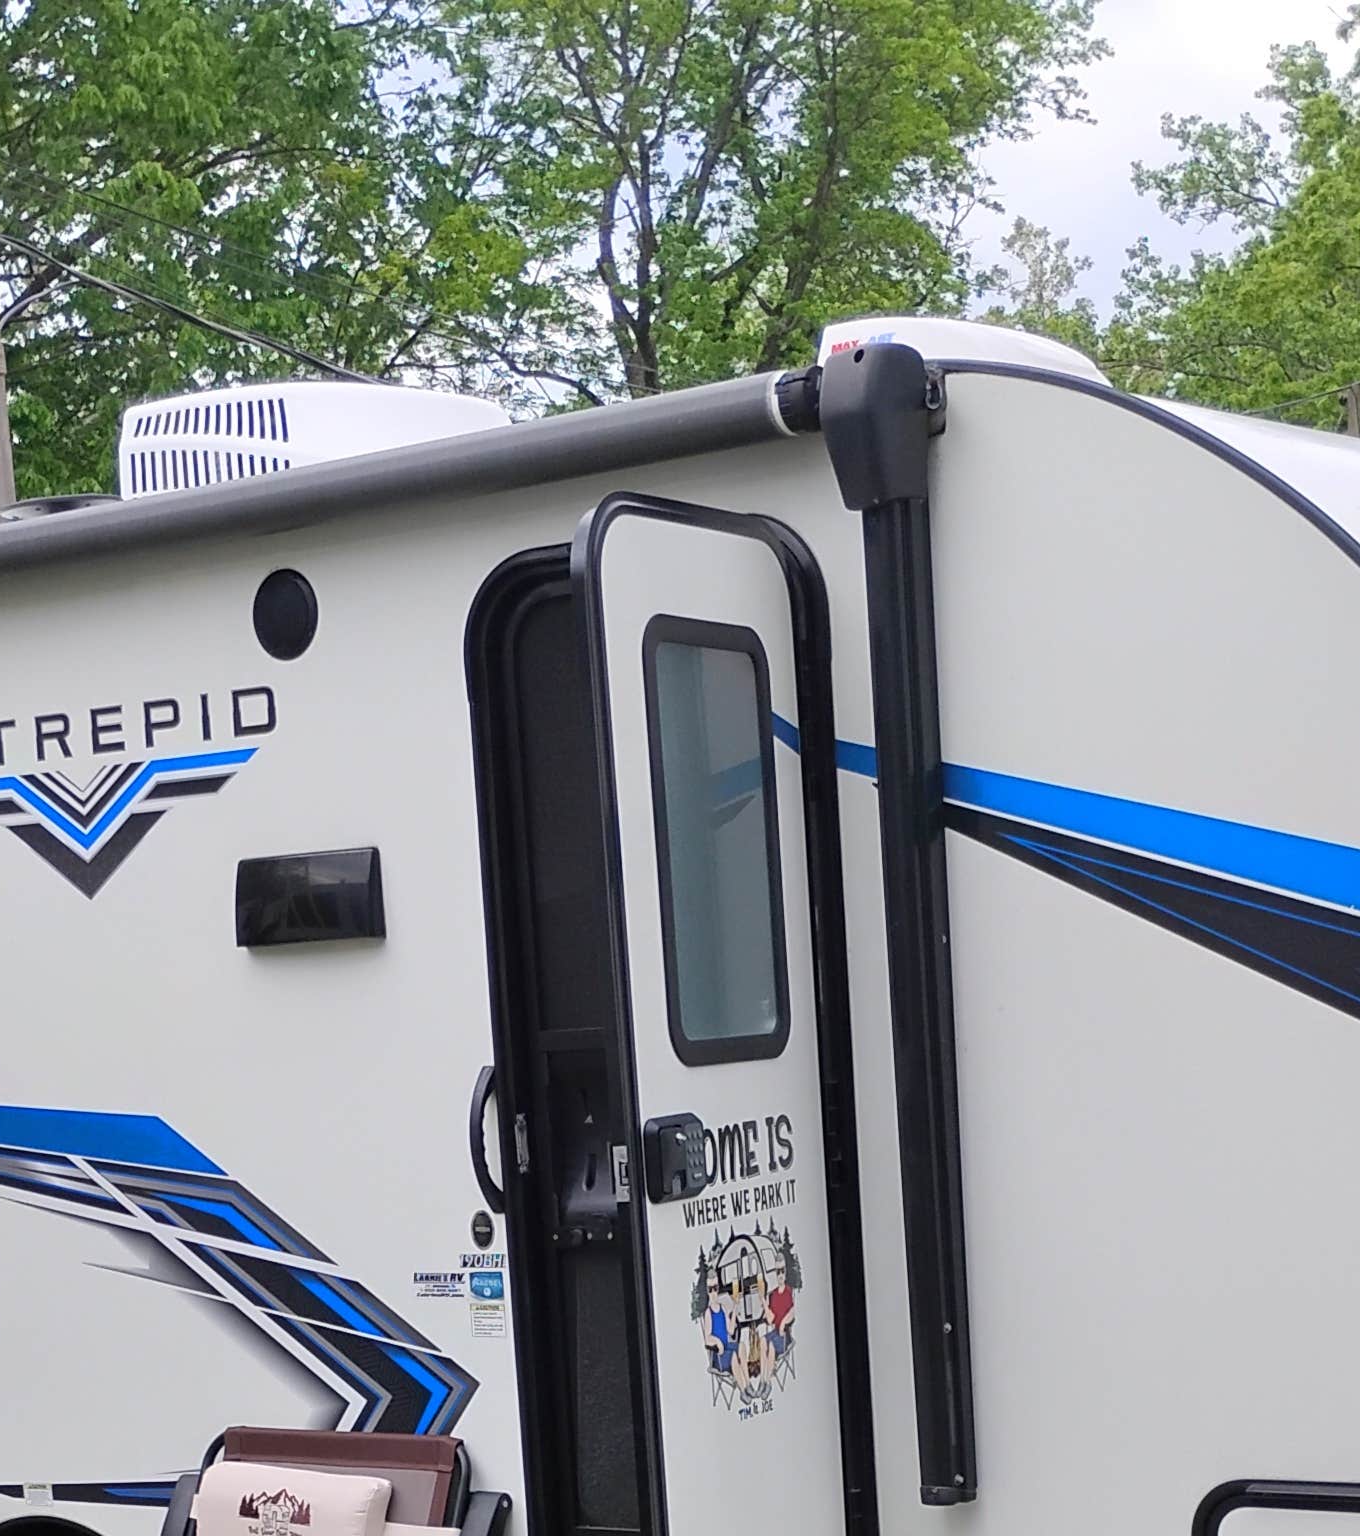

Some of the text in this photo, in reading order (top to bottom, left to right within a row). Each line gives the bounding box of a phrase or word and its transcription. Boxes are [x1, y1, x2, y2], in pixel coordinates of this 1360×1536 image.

[702, 1114, 794, 1186] OME IS
[683, 1179, 796, 1228] WHERE WE PARK IT
[460, 1253, 505, 1268] 190BH
